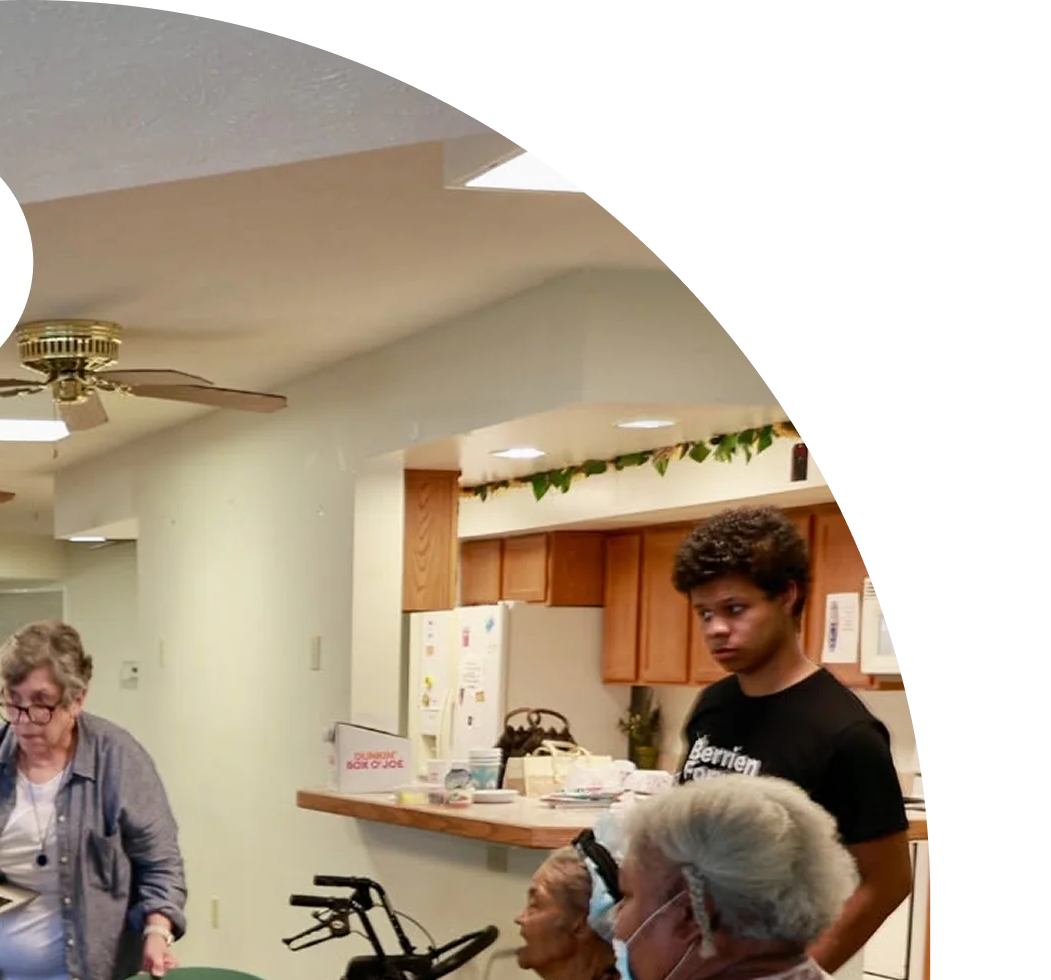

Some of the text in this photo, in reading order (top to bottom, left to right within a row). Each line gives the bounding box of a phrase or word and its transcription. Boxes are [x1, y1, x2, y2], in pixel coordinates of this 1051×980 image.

[346, 761, 368, 770] BOX
[382, 760, 404, 769] JOE
[688, 735, 762, 777] Berrien
